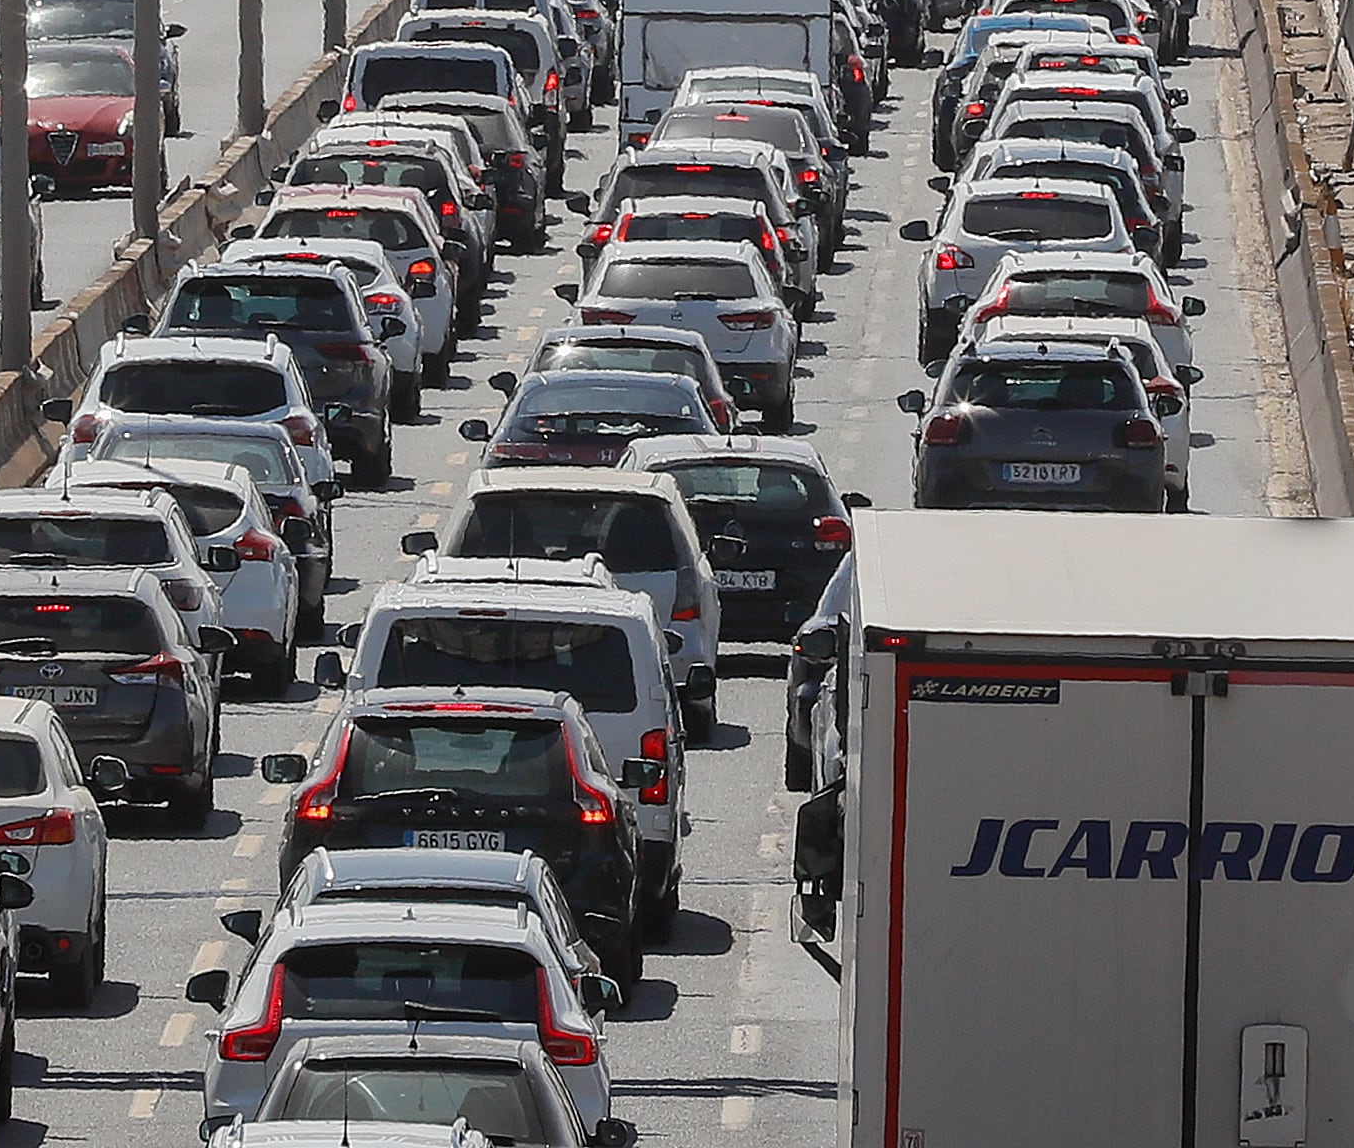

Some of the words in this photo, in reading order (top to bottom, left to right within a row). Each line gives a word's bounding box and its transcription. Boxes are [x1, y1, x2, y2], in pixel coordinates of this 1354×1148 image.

[63, 689, 94, 703] JXN
[941, 683, 1058, 699] LAMBERET
[418, 833, 461, 850] 6615
[466, 833, 499, 851] GYG
